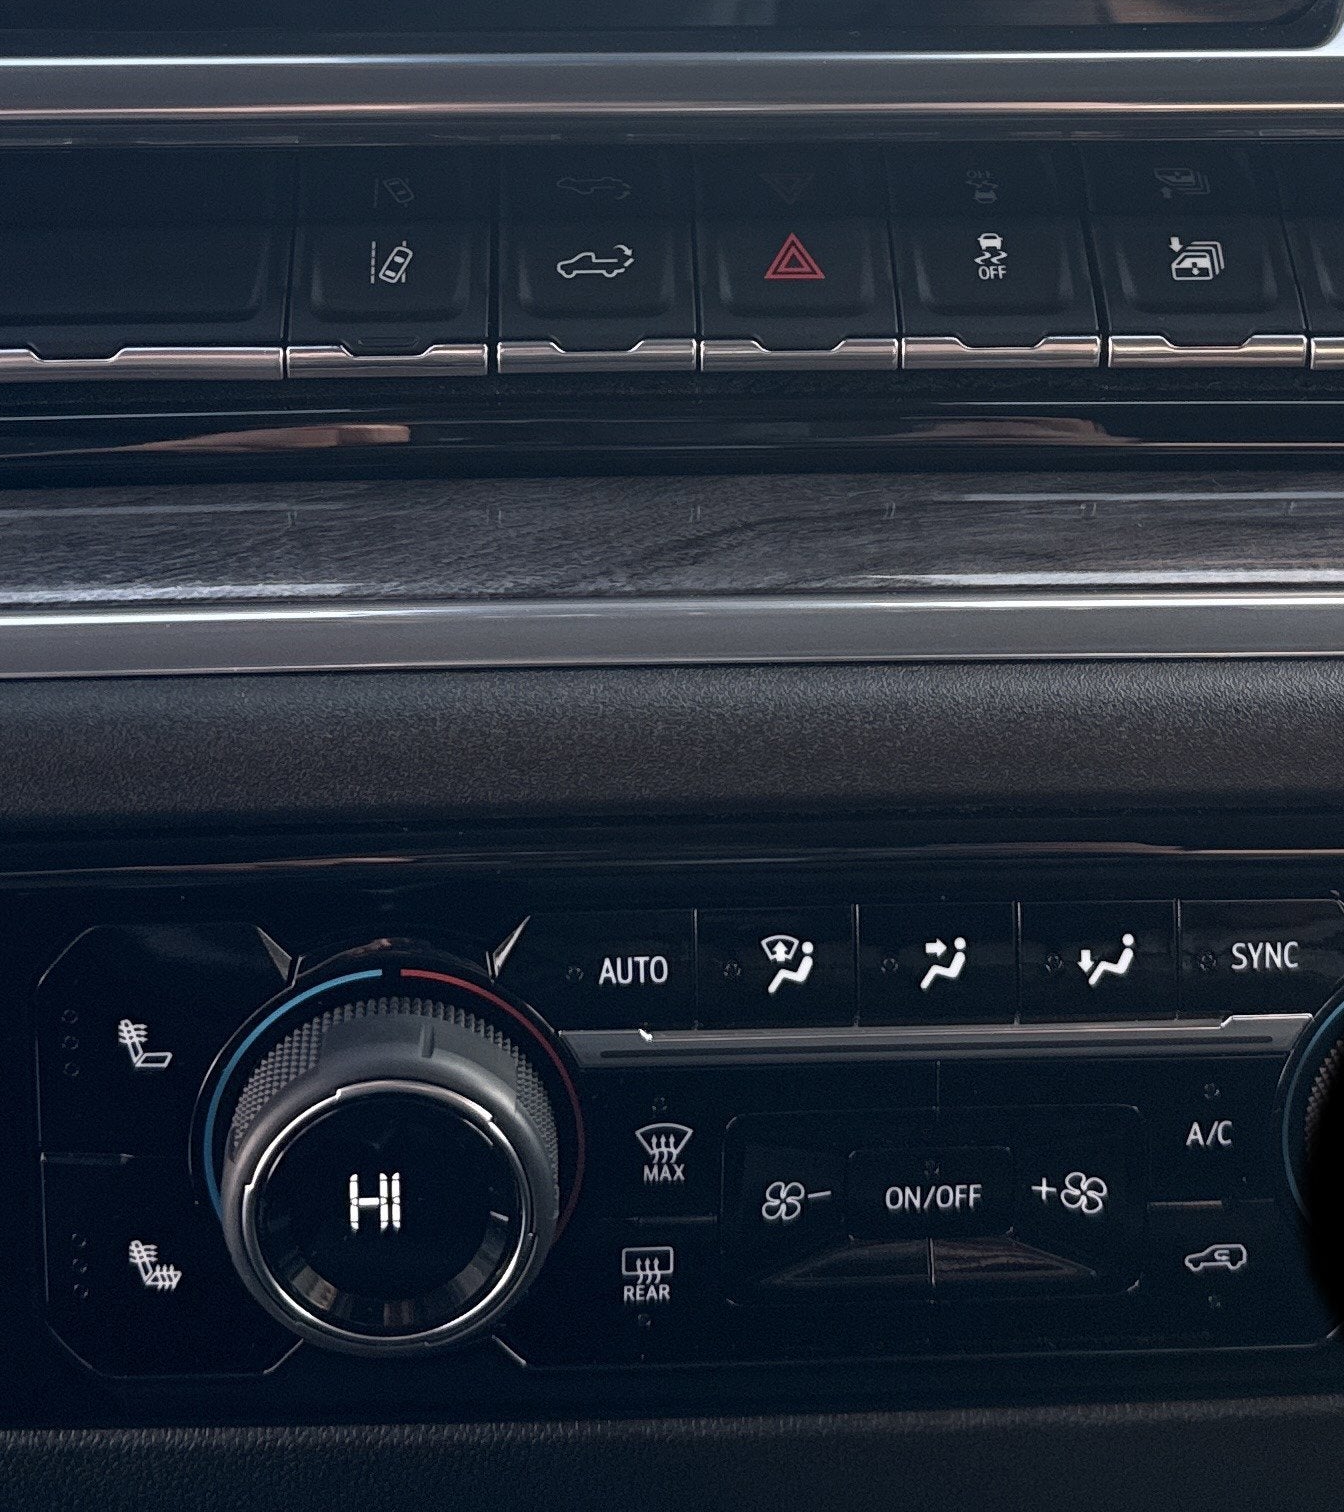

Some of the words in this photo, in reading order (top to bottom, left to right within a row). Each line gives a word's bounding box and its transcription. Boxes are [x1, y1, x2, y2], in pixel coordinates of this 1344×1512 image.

[978, 265, 1007, 280] OFF
[1231, 942, 1299, 970] SYNC
[598, 956, 669, 986] AUTO
[1185, 1120, 1233, 1147] A/C
[642, 1163, 686, 1183] MAX
[349, 1172, 401, 1231] HI
[885, 1184, 982, 1210] ON/OFF
[622, 1283, 671, 1302] REAR
